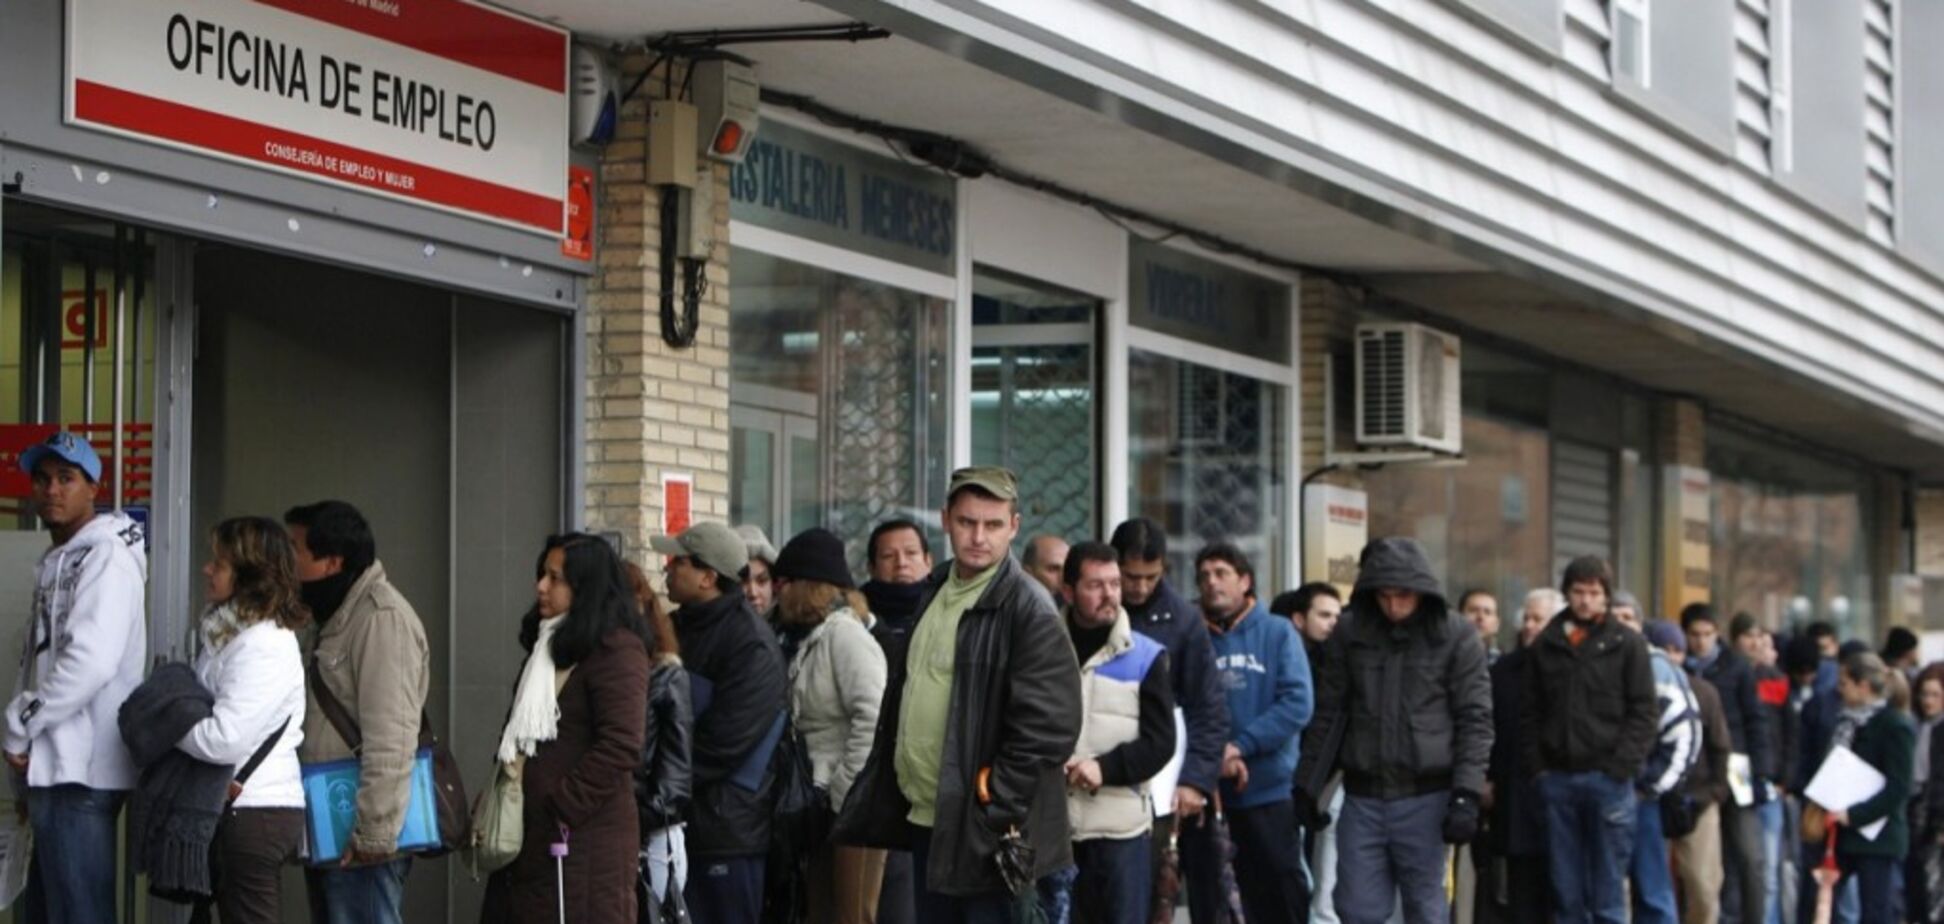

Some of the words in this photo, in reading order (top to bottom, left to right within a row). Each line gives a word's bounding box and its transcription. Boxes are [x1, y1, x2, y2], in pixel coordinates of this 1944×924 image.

[167, 13, 309, 102] OFICINA
[320, 55, 362, 116] DE
[373, 70, 496, 151] EMPLEO
[265, 141, 324, 168] CONSEJERÍA
[324, 156, 338, 172] DE
[339, 160, 376, 181] EMPLEO
[376, 168, 384, 182] Y
[385, 171, 415, 190] MUJER
[861, 173, 953, 255] MENESES
